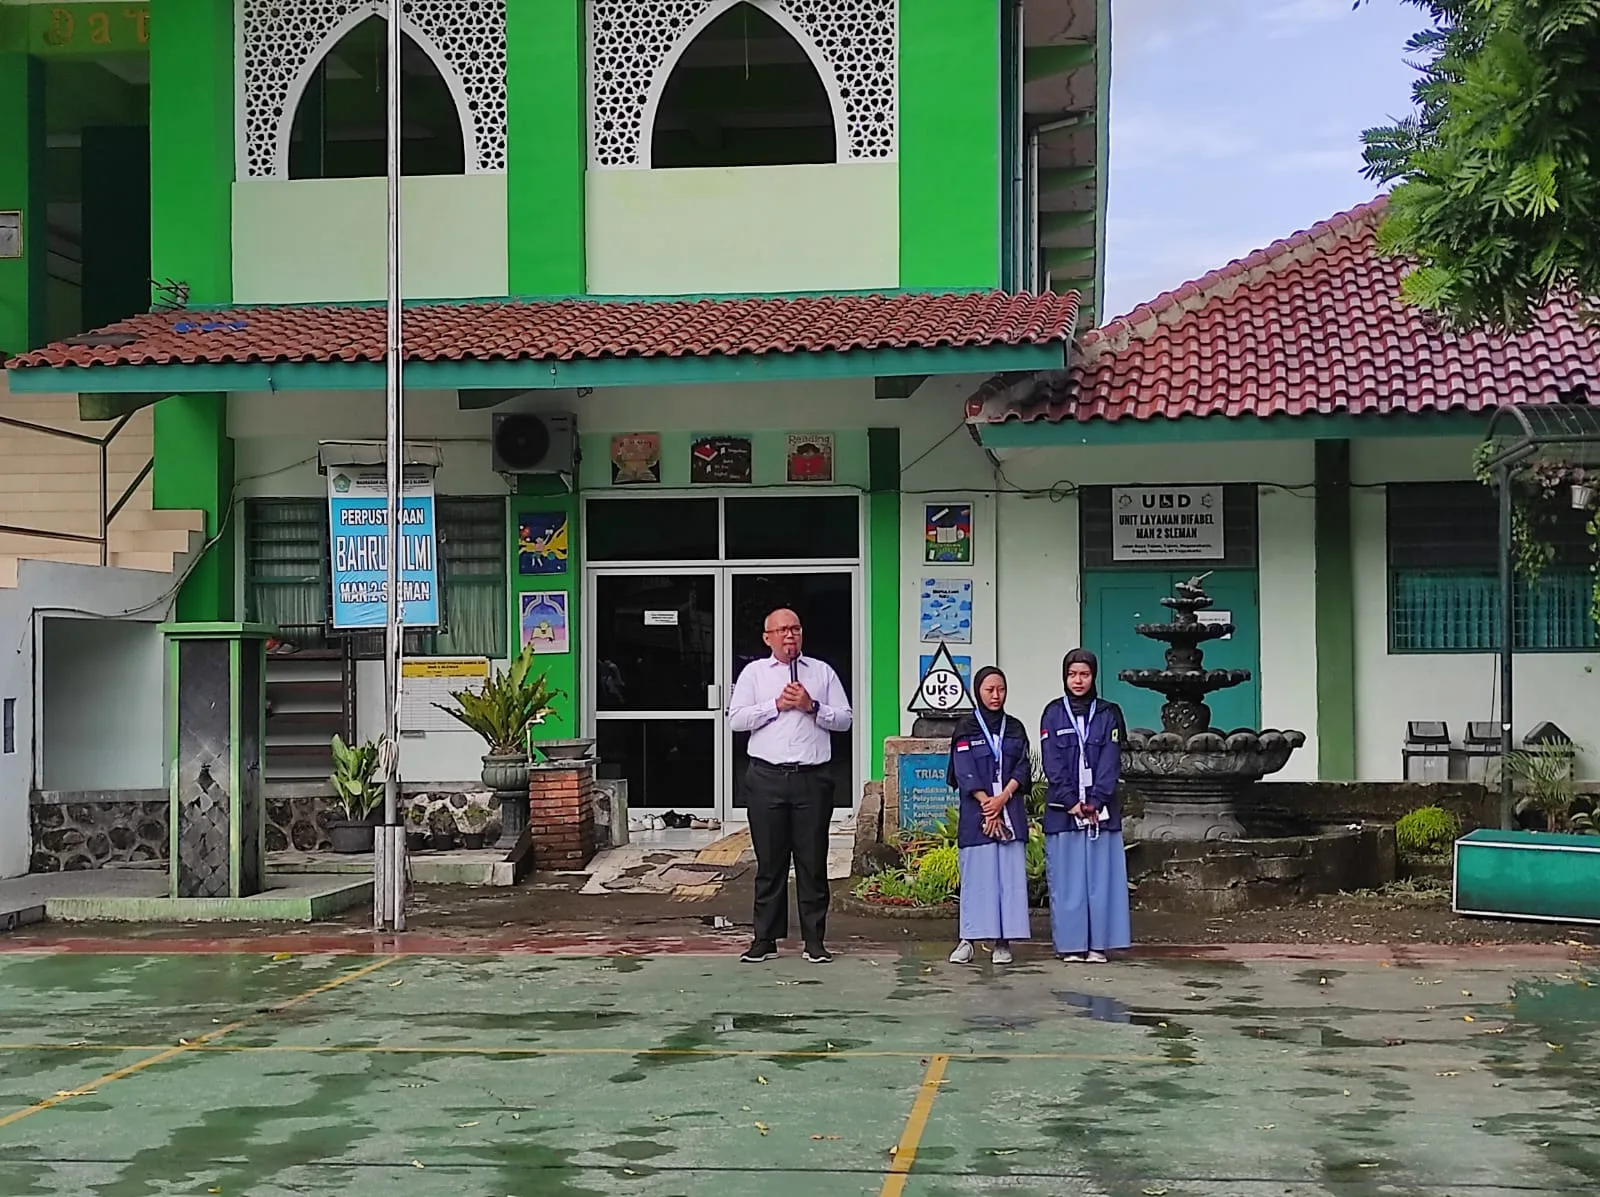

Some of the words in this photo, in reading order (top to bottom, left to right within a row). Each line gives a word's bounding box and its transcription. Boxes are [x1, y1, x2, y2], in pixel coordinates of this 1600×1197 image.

[341, 508, 424, 525] PERPUSTAAN
[1119, 515, 1138, 525] UNIT
[1140, 514, 1179, 525] LAYANAN
[1181, 514, 1214, 525] DIFABEL
[1136, 528, 1155, 538] MAN
[1156, 528, 1163, 538] 2
[1164, 528, 1198, 538] SLEMAN
[336, 535, 390, 572] BAHRU
[340, 581, 367, 603] MAN
[370, 581, 379, 603] 2
[381, 580, 431, 603] SEMAN
[914, 769, 945, 779] TRIAS
